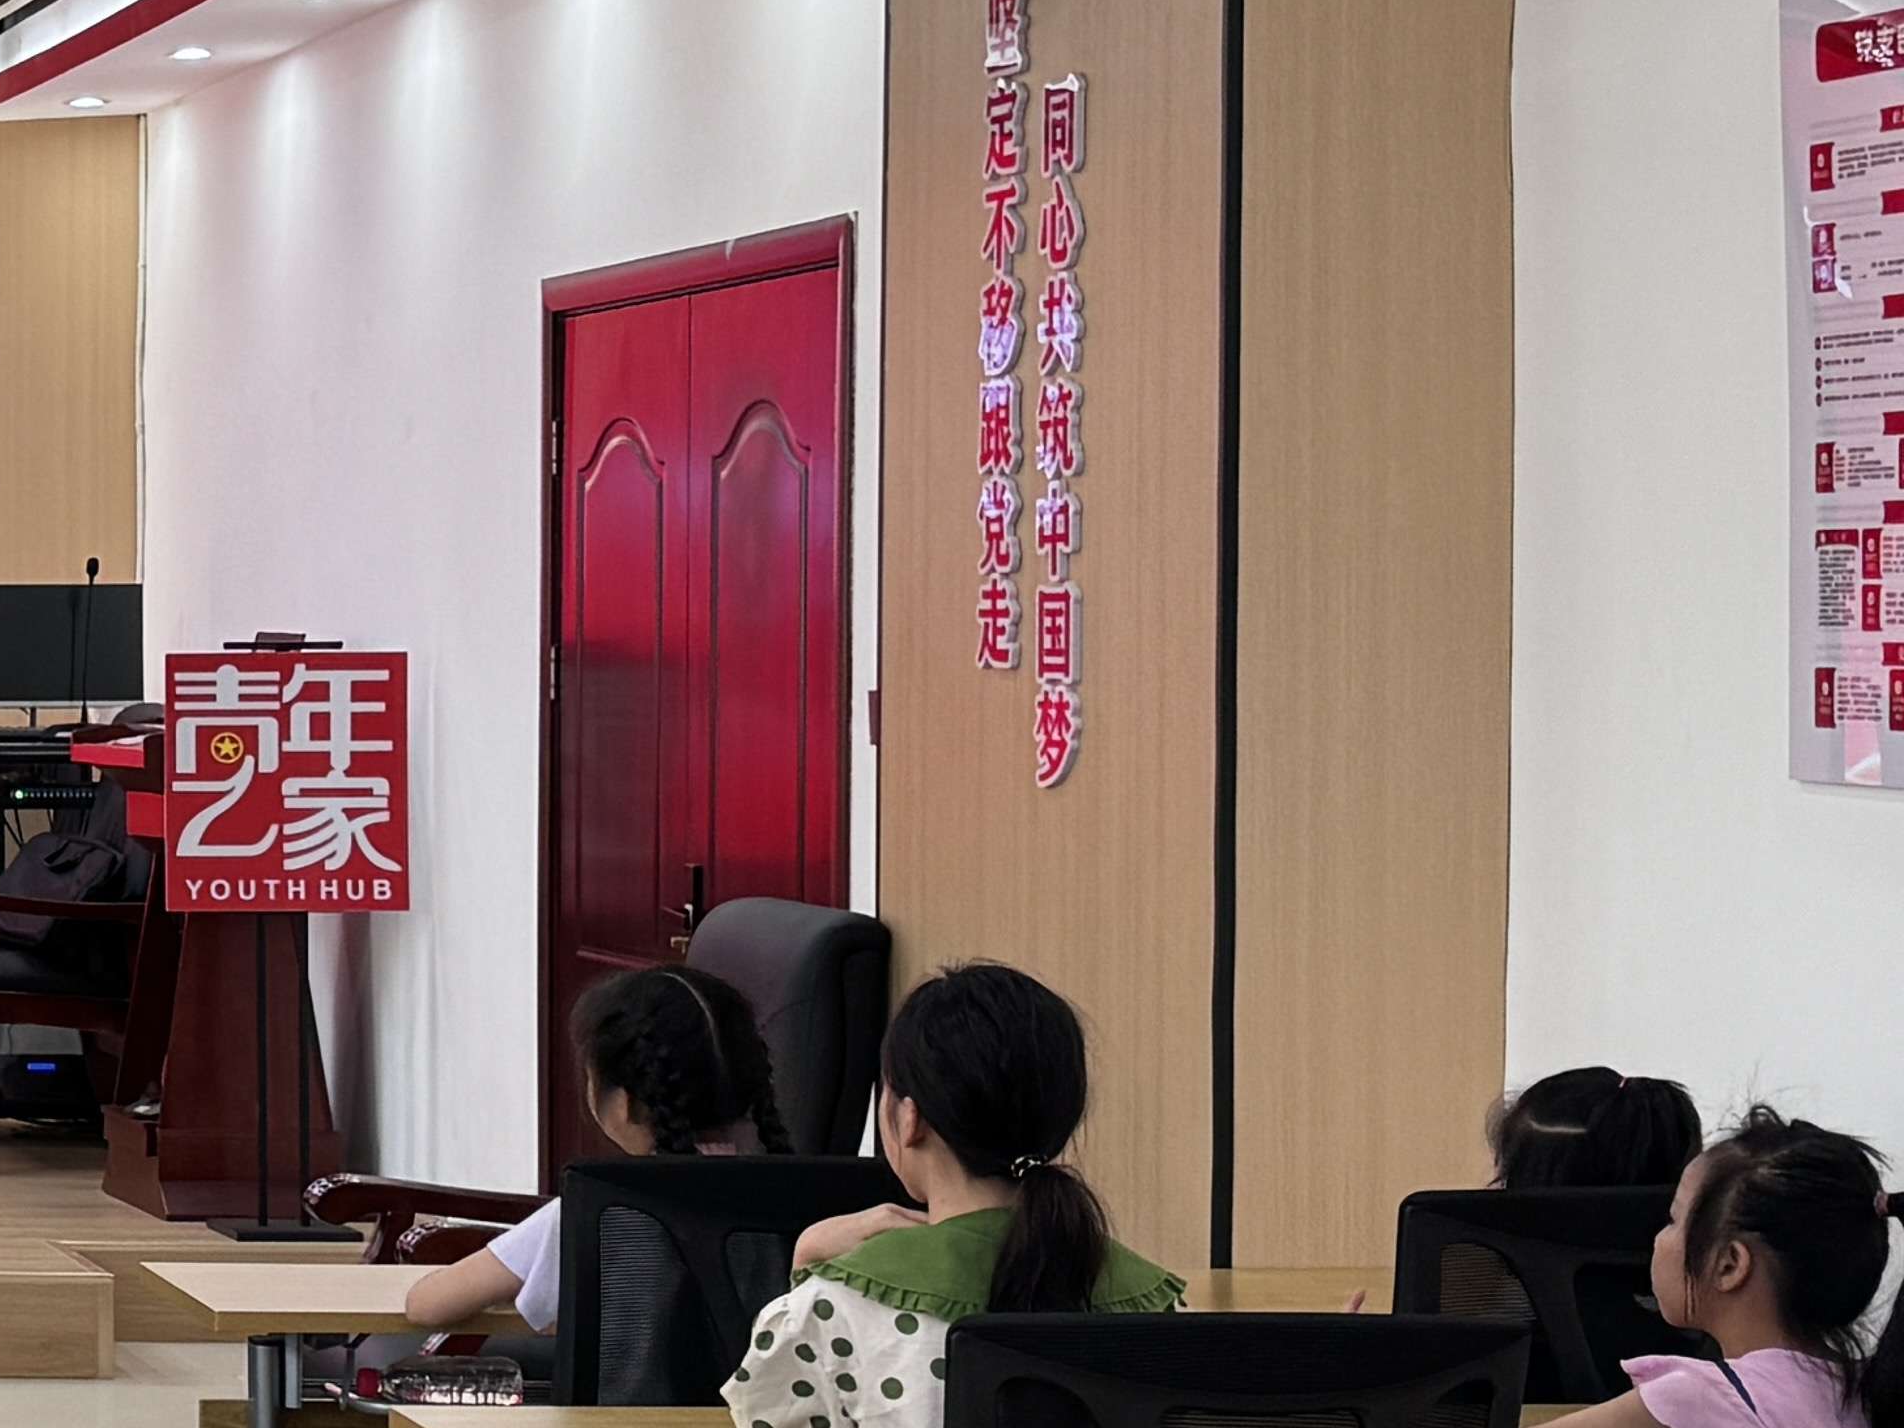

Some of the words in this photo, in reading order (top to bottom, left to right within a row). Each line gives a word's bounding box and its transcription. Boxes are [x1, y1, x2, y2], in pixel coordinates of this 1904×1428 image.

[1036, 73, 1081, 788] 同心共筑中国梦
[184, 878, 307, 902] YOUTH
[320, 878, 393, 902] HUB
